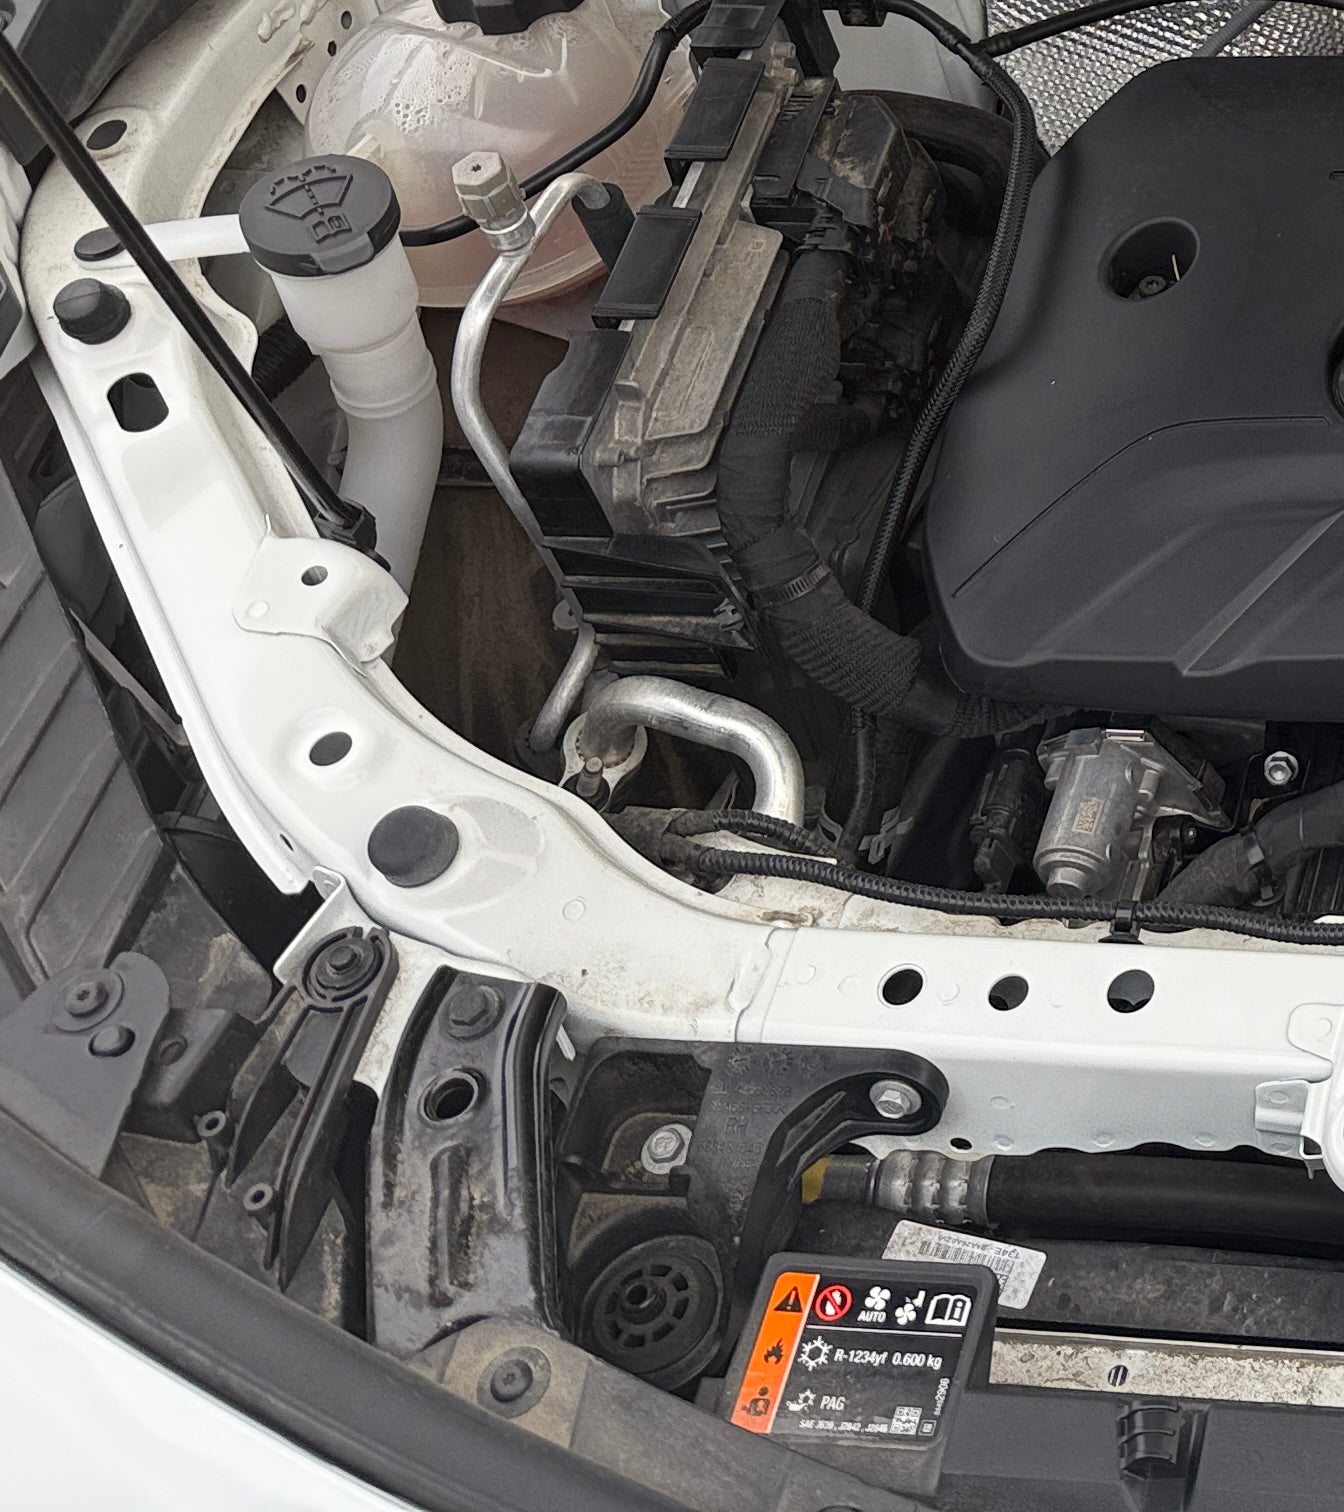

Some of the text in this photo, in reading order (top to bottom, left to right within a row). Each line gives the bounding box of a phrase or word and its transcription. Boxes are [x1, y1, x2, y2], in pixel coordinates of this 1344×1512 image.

[857, 1310, 887, 1323] AUTO
[833, 1350, 943, 1371] R-1234yf 0.600 kg
[820, 1395, 846, 1411] PAG
